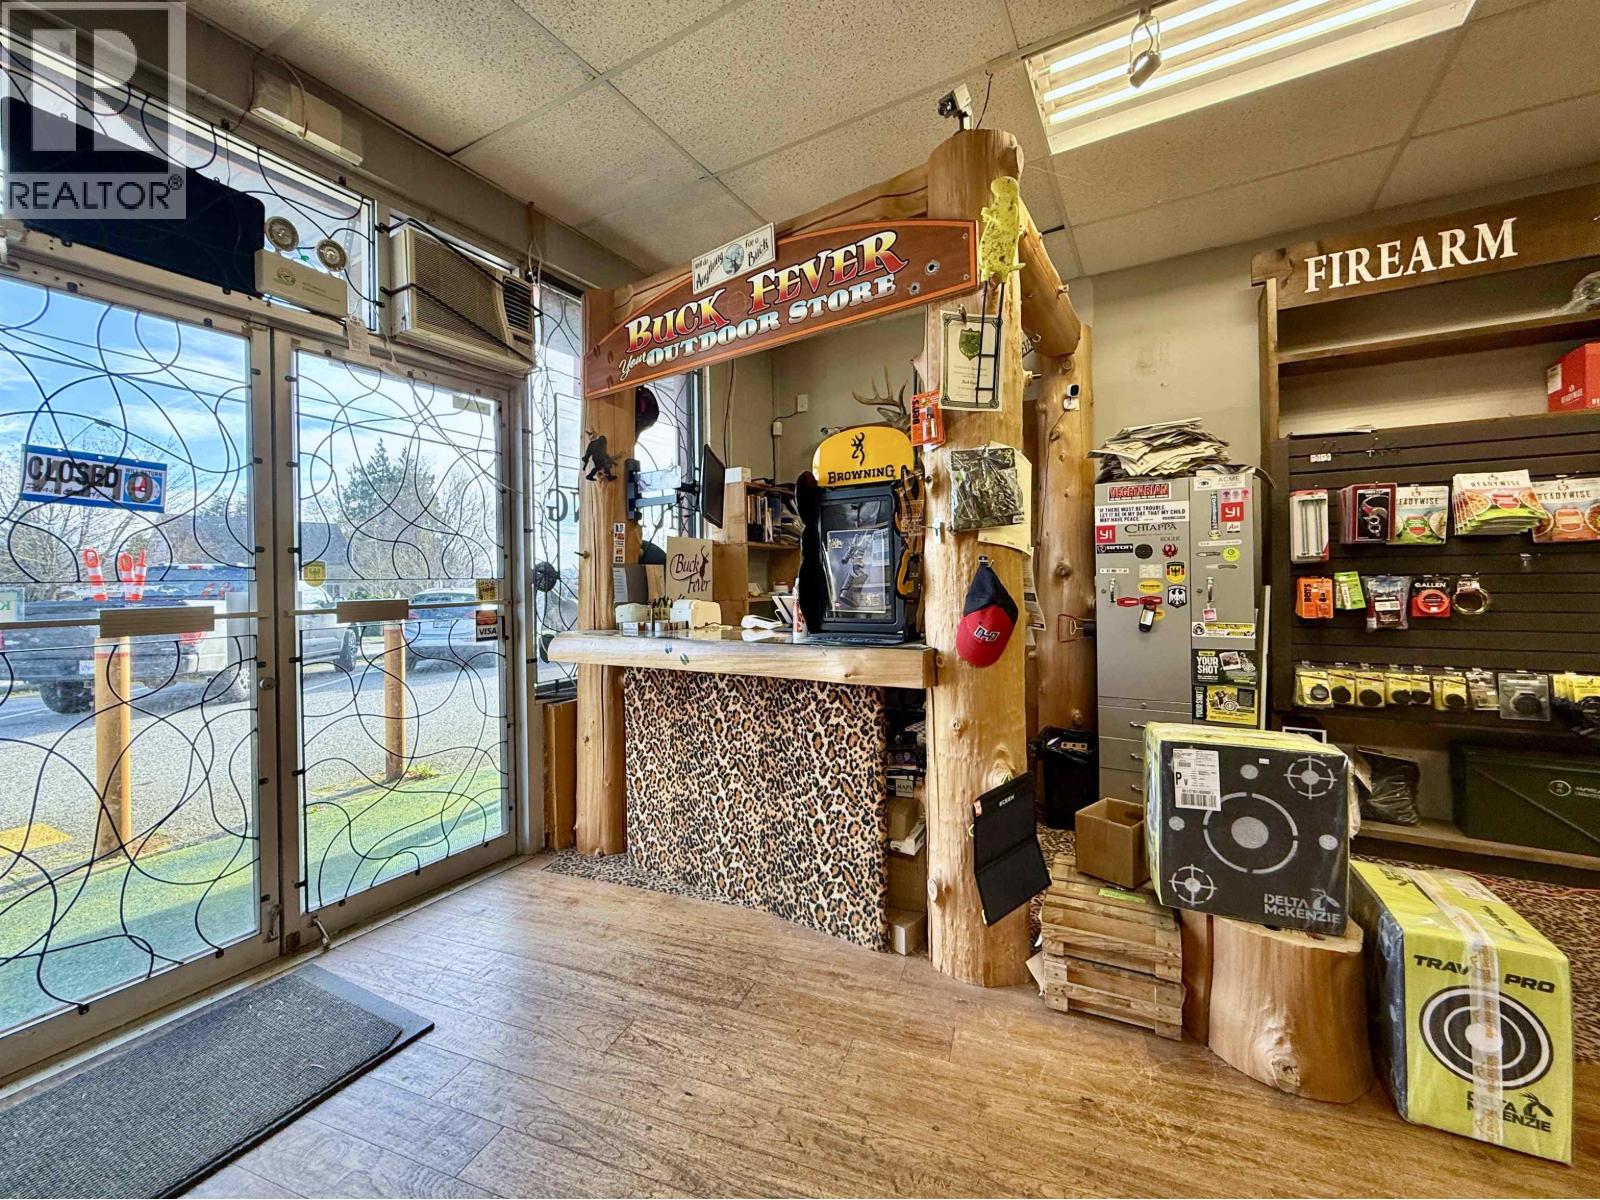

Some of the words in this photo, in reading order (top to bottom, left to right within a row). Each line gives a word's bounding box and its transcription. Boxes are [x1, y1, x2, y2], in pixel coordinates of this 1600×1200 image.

[1304, 217, 1518, 294] FIREARM
[624, 288, 730, 354] BUCK
[746, 230, 909, 314] FEVER
[619, 351, 648, 381] Your
[646, 311, 782, 368] OUTDOOR
[788, 273, 897, 323] STORE
[28, 456, 119, 489] CLOSED
[828, 465, 895, 484] BROWNING
[1125, 522, 1177, 533] CHIAPPA
[671, 553, 700, 579] Buck
[687, 576, 711, 594] Fever
[479, 627, 497, 635] VISA
[1196, 656, 1219, 665] YOUR
[1197, 665, 1219, 674] SHOT
[1176, 772, 1182, 785] P
[1264, 893, 1310, 909] DELTA
[1264, 904, 1341, 923] McKENZIE
[1413, 954, 1476, 976] TRAV
[1504, 973, 1556, 994] PRO
